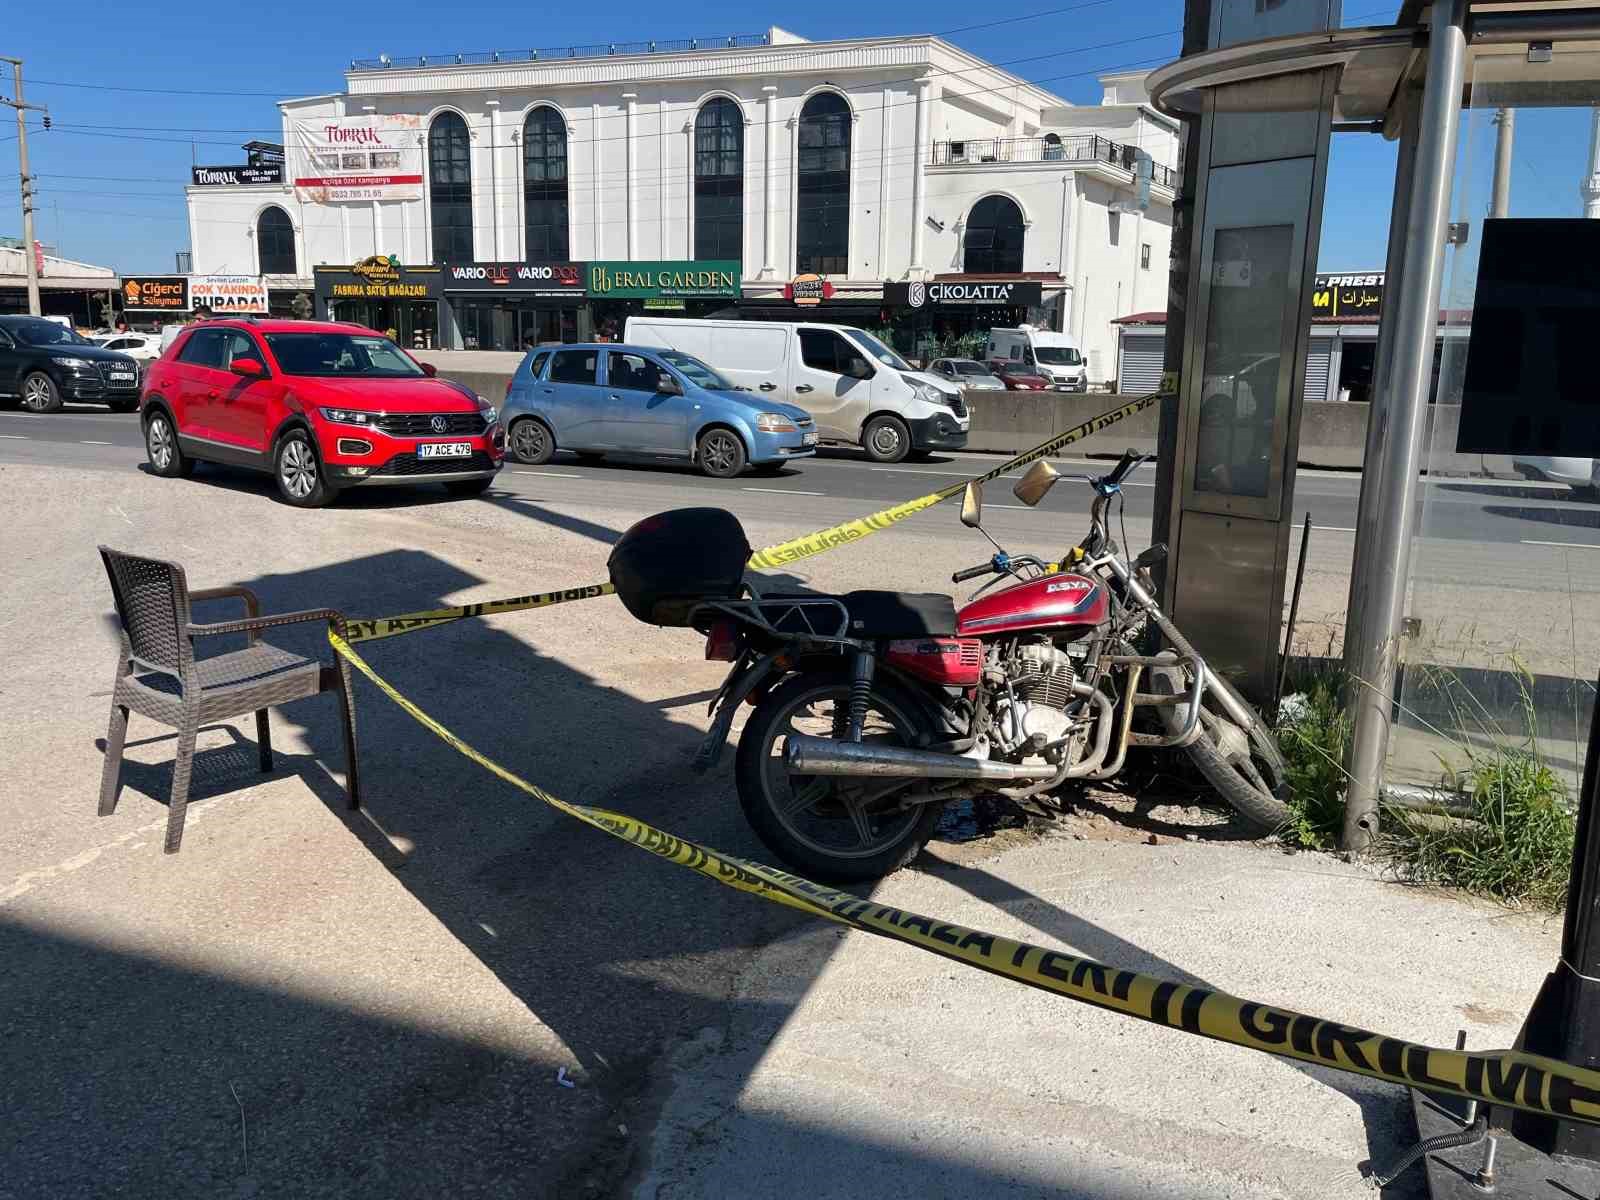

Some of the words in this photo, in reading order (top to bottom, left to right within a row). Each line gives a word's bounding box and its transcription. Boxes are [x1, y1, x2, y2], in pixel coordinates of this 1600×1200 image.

[324, 125, 382, 144] TOPRAK
[195, 168, 241, 184] TOPRAK
[615, 271, 656, 287] ERAL
[658, 271, 734, 287] GARDEN
[142, 282, 183, 297] Ciğerci
[217, 284, 265, 295] YAKINDA
[142, 296, 183, 307] Süleyman
[424, 445, 433, 456] 17
[435, 445, 453, 456] ACE
[455, 444, 471, 455] 479
